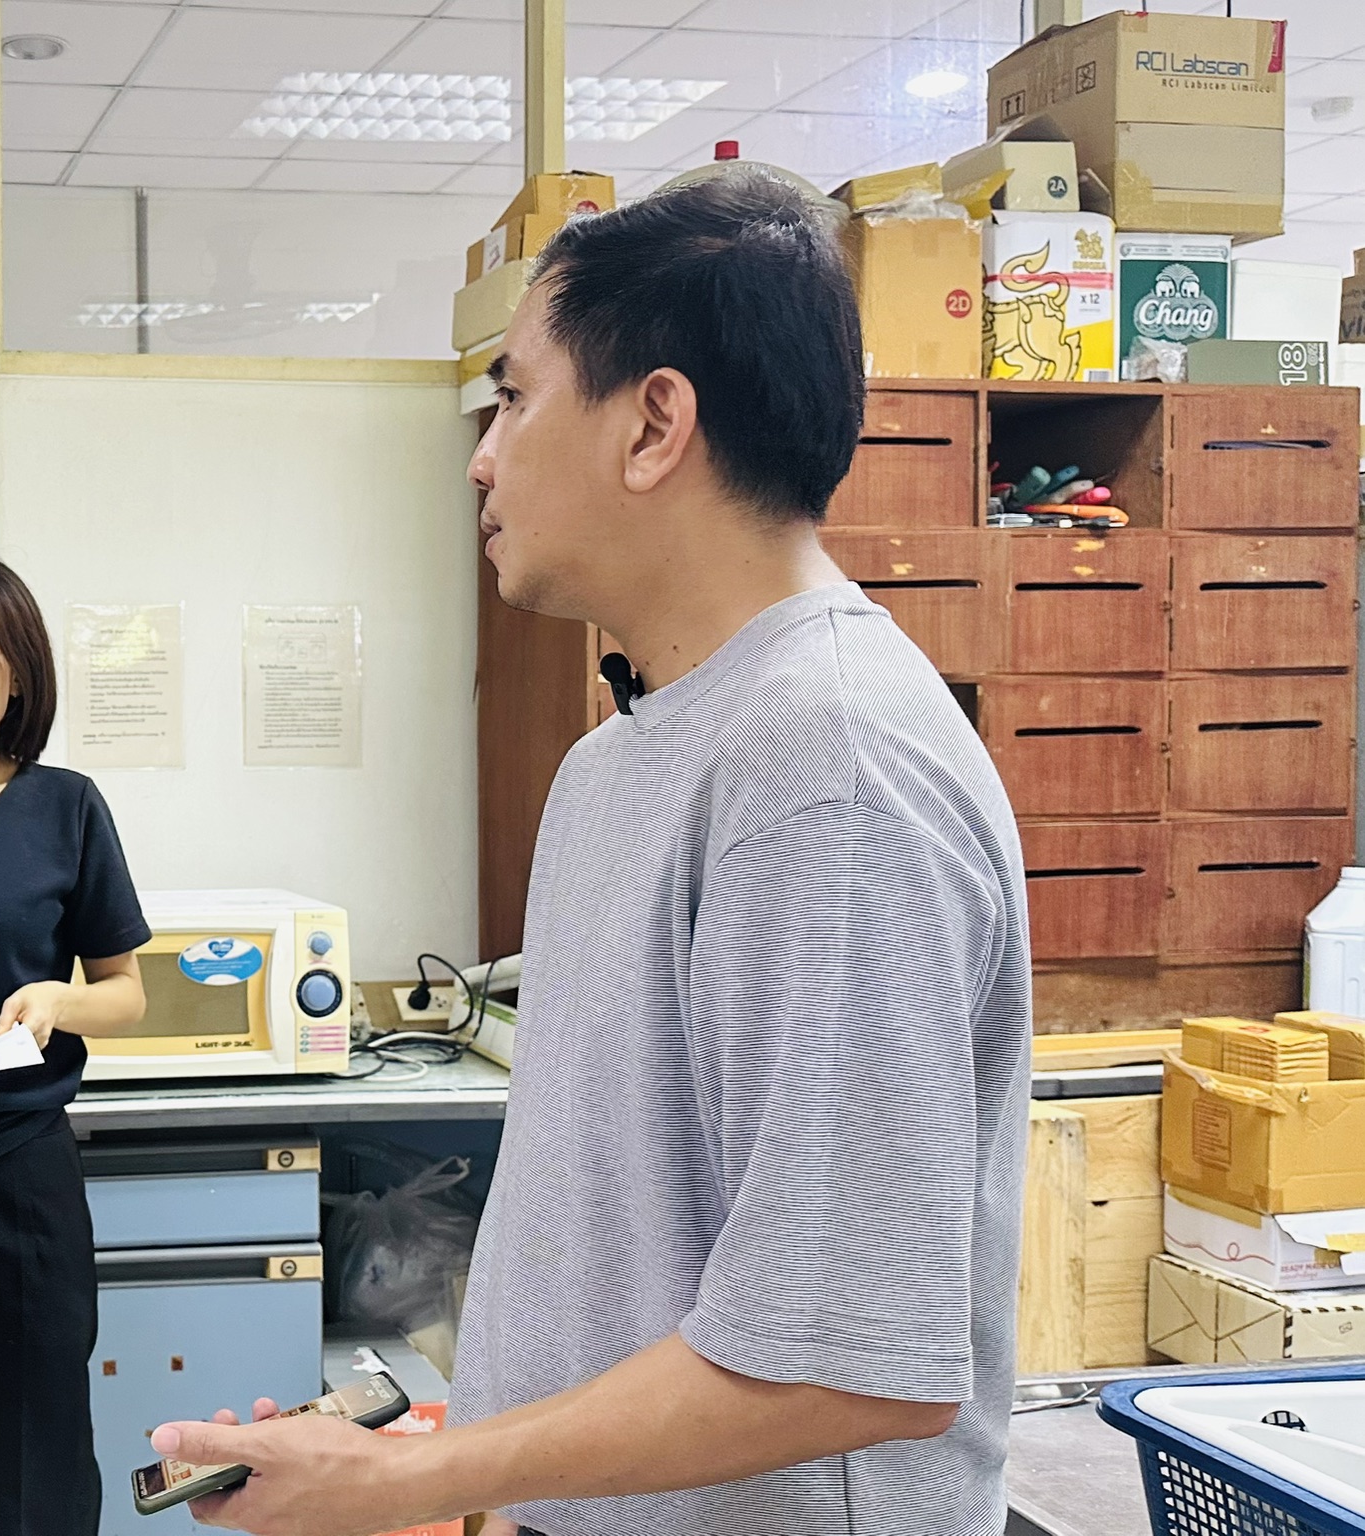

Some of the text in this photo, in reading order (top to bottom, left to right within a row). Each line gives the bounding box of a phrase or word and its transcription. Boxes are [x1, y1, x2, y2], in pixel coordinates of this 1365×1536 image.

[1136, 51, 1249, 76] RCI Labscan
[1161, 78, 1180, 88] RCI
[1185, 80, 1226, 90] Labscan
[1048, 178, 1067, 192] 2A
[948, 296, 970, 312] 2D
[1090, 293, 1100, 304] 12
[1139, 299, 1213, 332] Chang
[1278, 342, 1308, 386] 18
